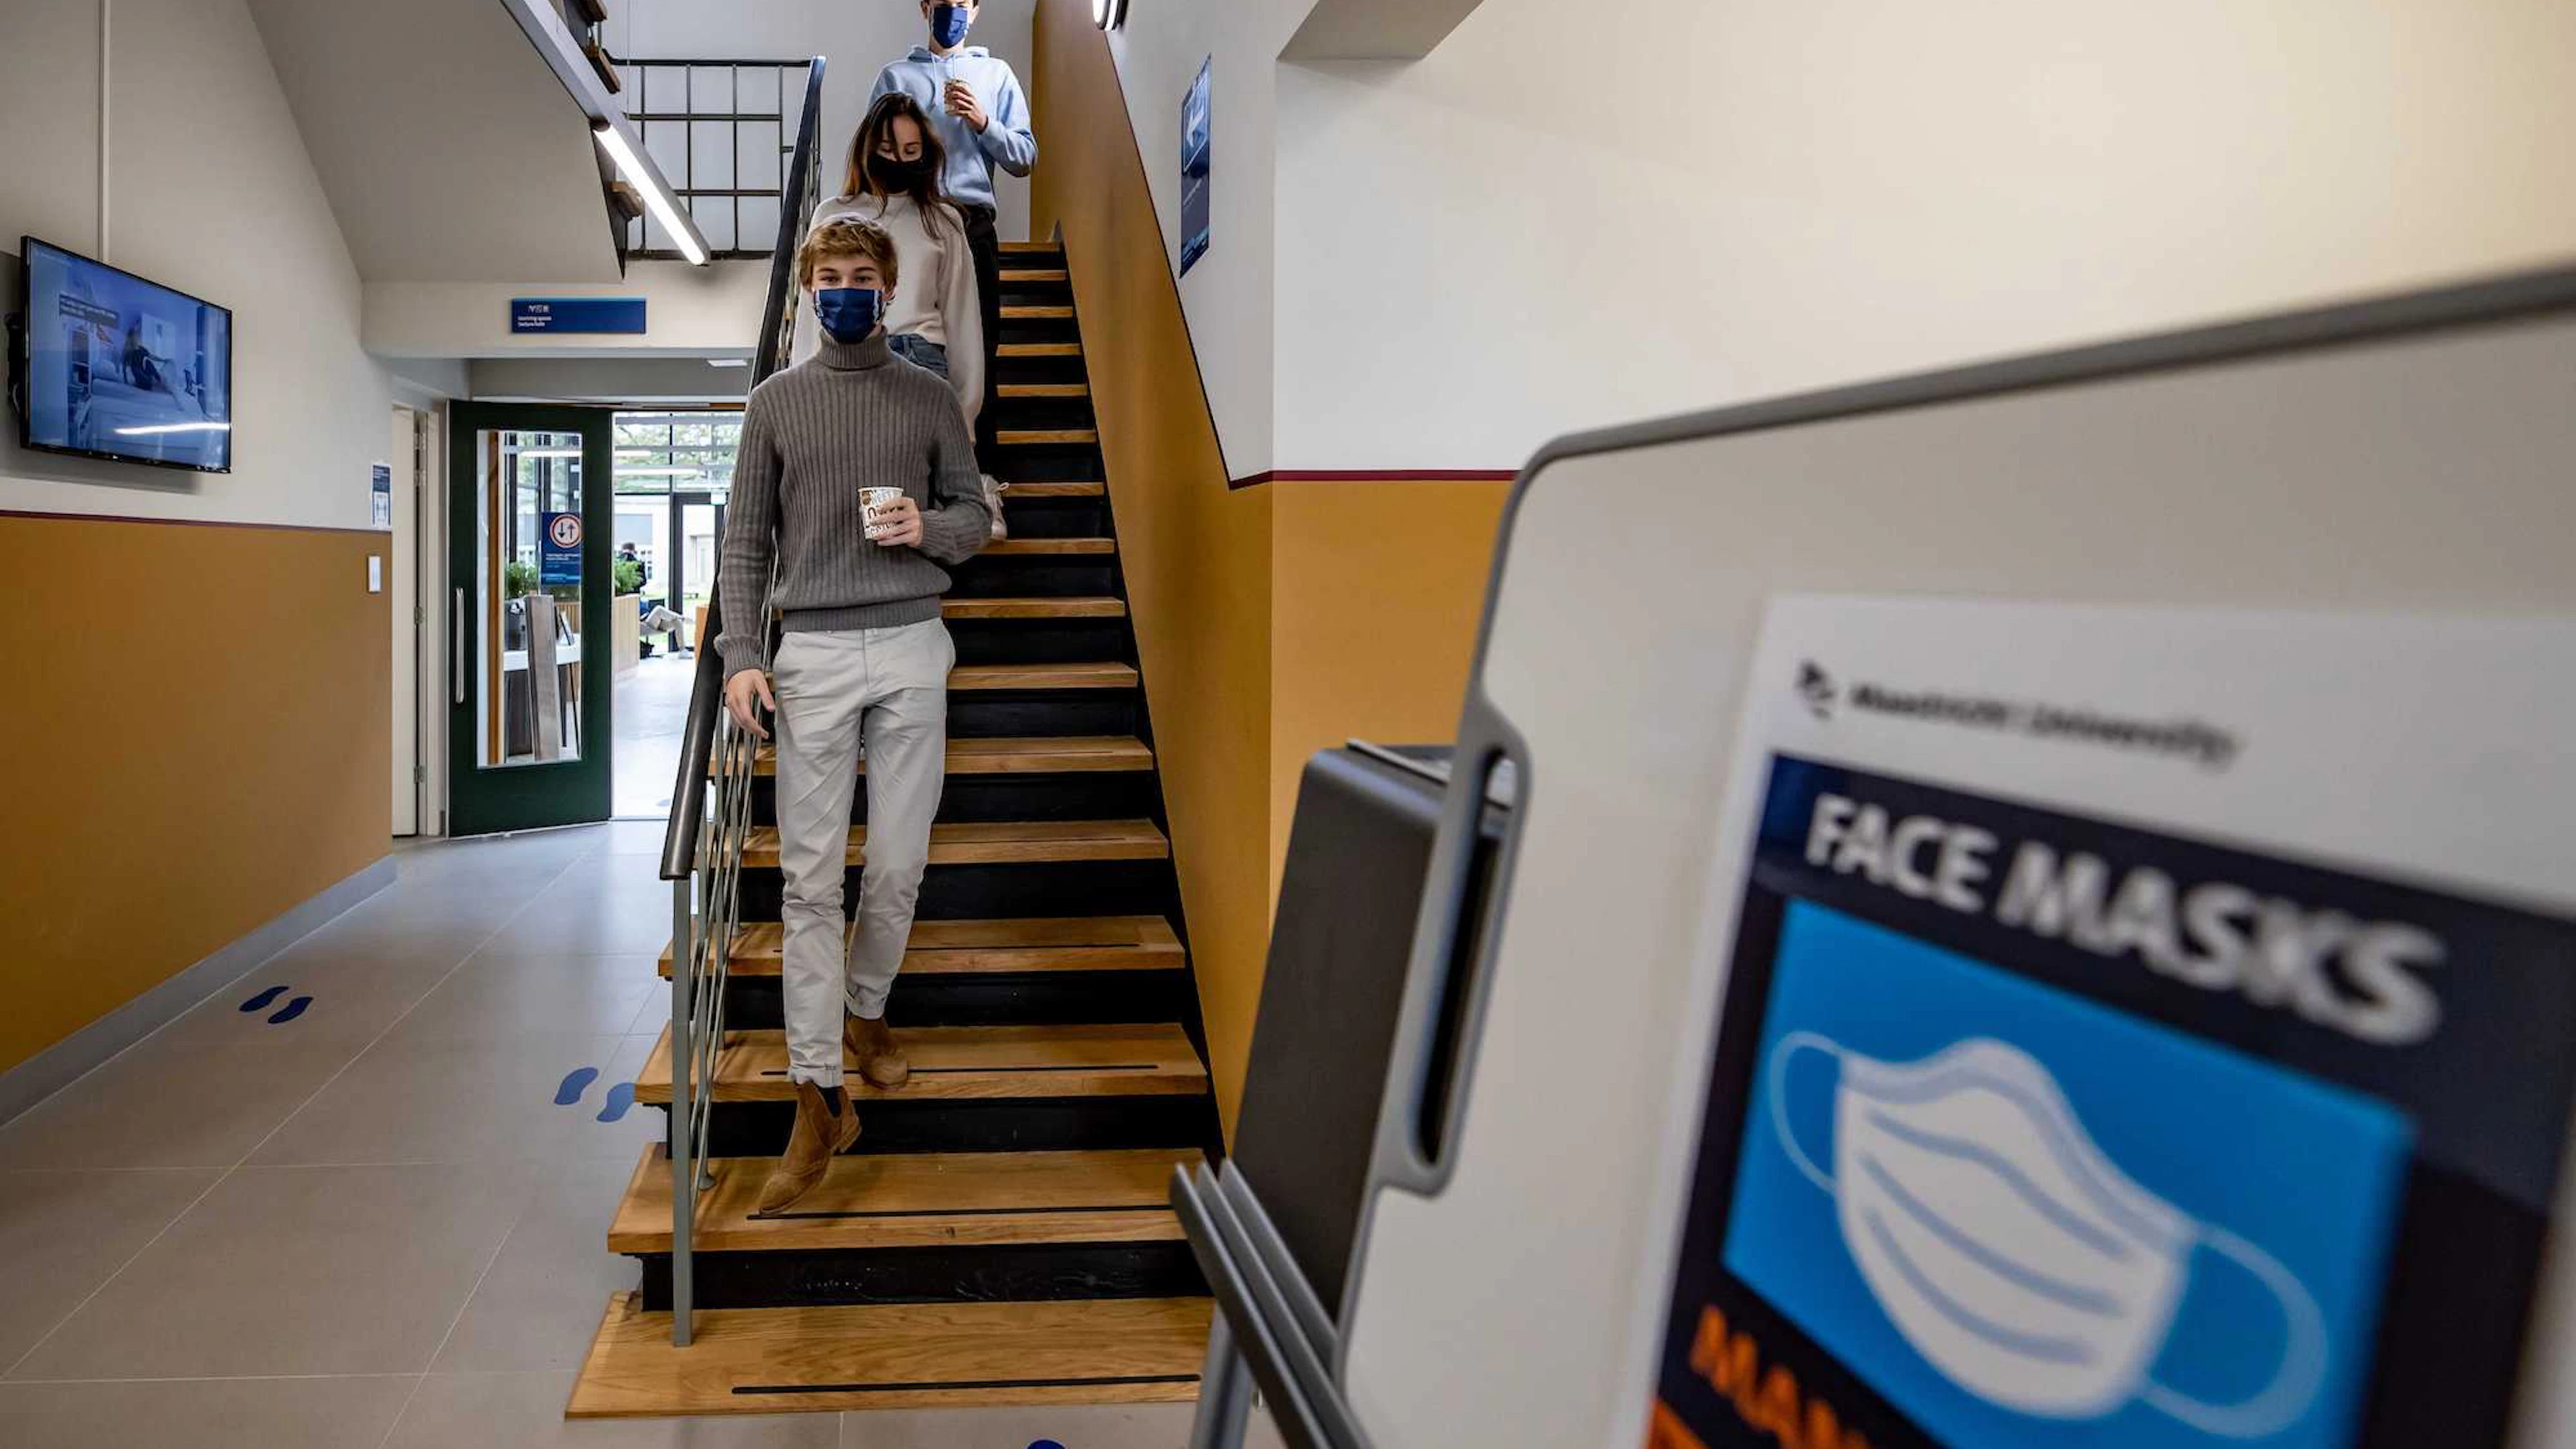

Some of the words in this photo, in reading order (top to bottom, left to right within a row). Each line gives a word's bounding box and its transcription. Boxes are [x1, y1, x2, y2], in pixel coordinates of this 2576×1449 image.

[2026, 706, 2240, 769] University
[1805, 793, 1997, 912] FACE
[1996, 842, 2439, 1043] MASKS
